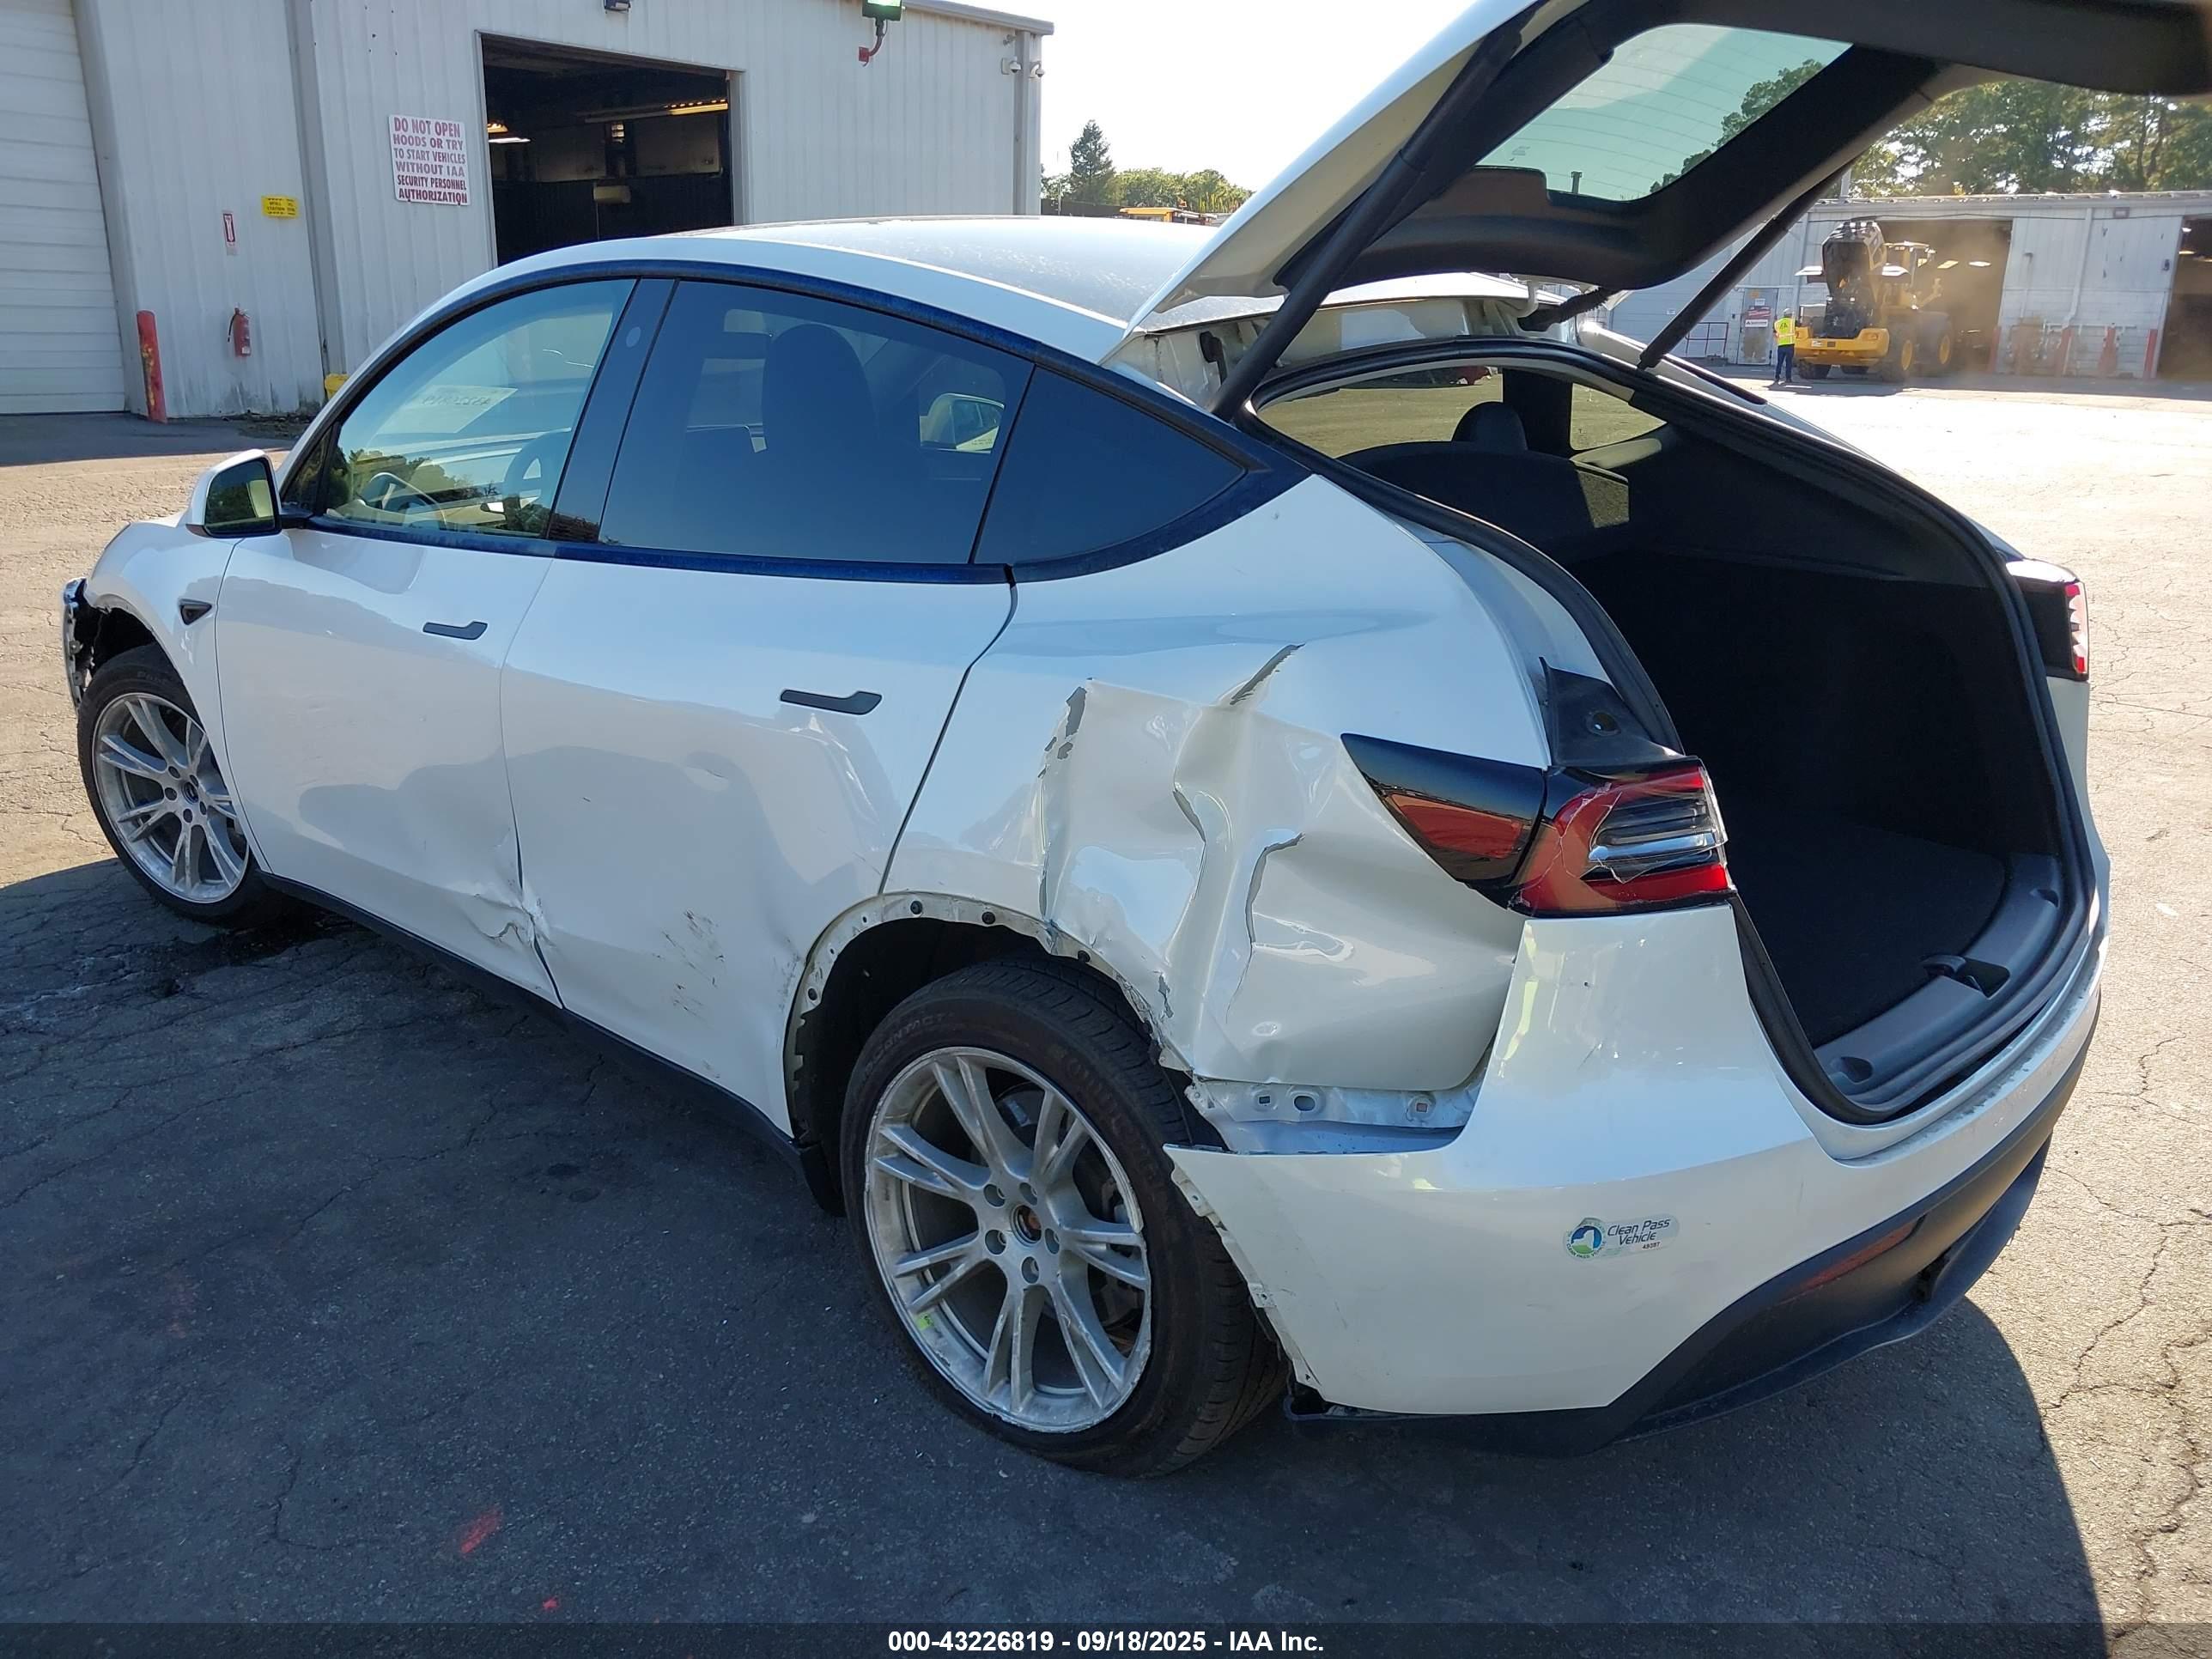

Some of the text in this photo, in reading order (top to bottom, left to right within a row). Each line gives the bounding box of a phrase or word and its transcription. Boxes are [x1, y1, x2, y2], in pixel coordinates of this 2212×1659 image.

[393, 117, 460, 137] DO NOT OPEN
[393, 134, 463, 150] HOODS OR TRY
[393, 148, 465, 164] TO START VEHICLES
[395, 161, 465, 177] WITHOUT IAA
[398, 174, 467, 191] SECURITY PERSONNEL
[399, 188, 468, 204] AUTHORIZATION
[1607, 1224, 1639, 1236] Clean
[1642, 1219, 1671, 1231] Pass
[1619, 1231, 1656, 1245] Vehicle
